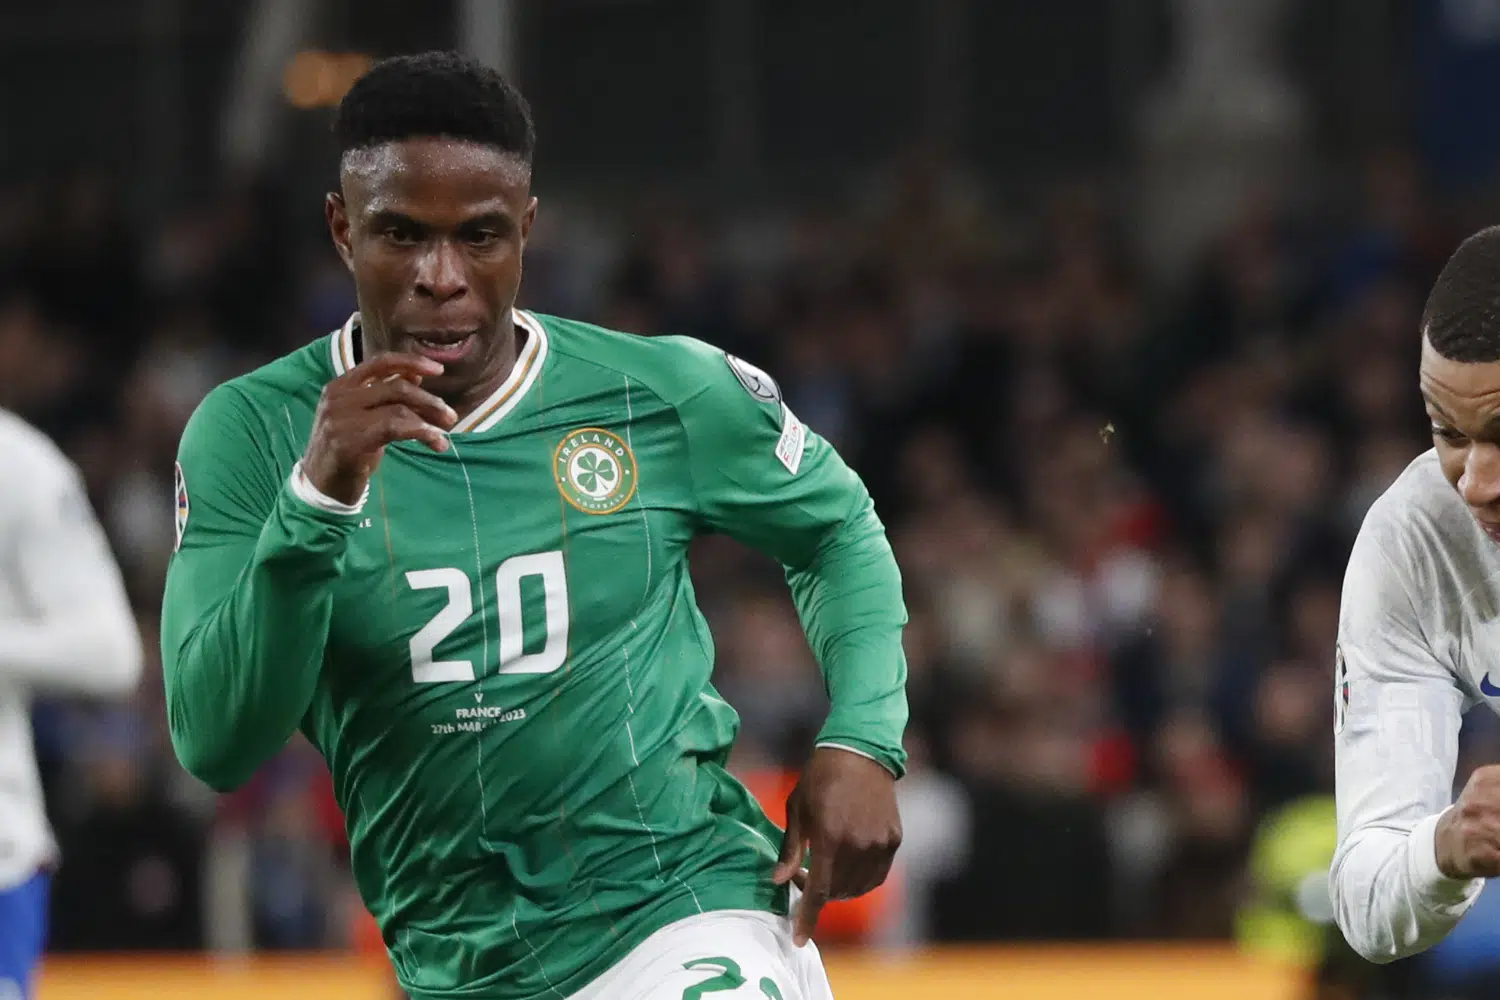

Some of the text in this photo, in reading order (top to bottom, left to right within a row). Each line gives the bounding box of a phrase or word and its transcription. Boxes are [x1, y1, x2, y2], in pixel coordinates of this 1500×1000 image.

[558, 433, 624, 463] IRELAND
[405, 550, 569, 683] 20
[431, 724, 455, 734] 27th
[457, 718, 496, 732] MAR
